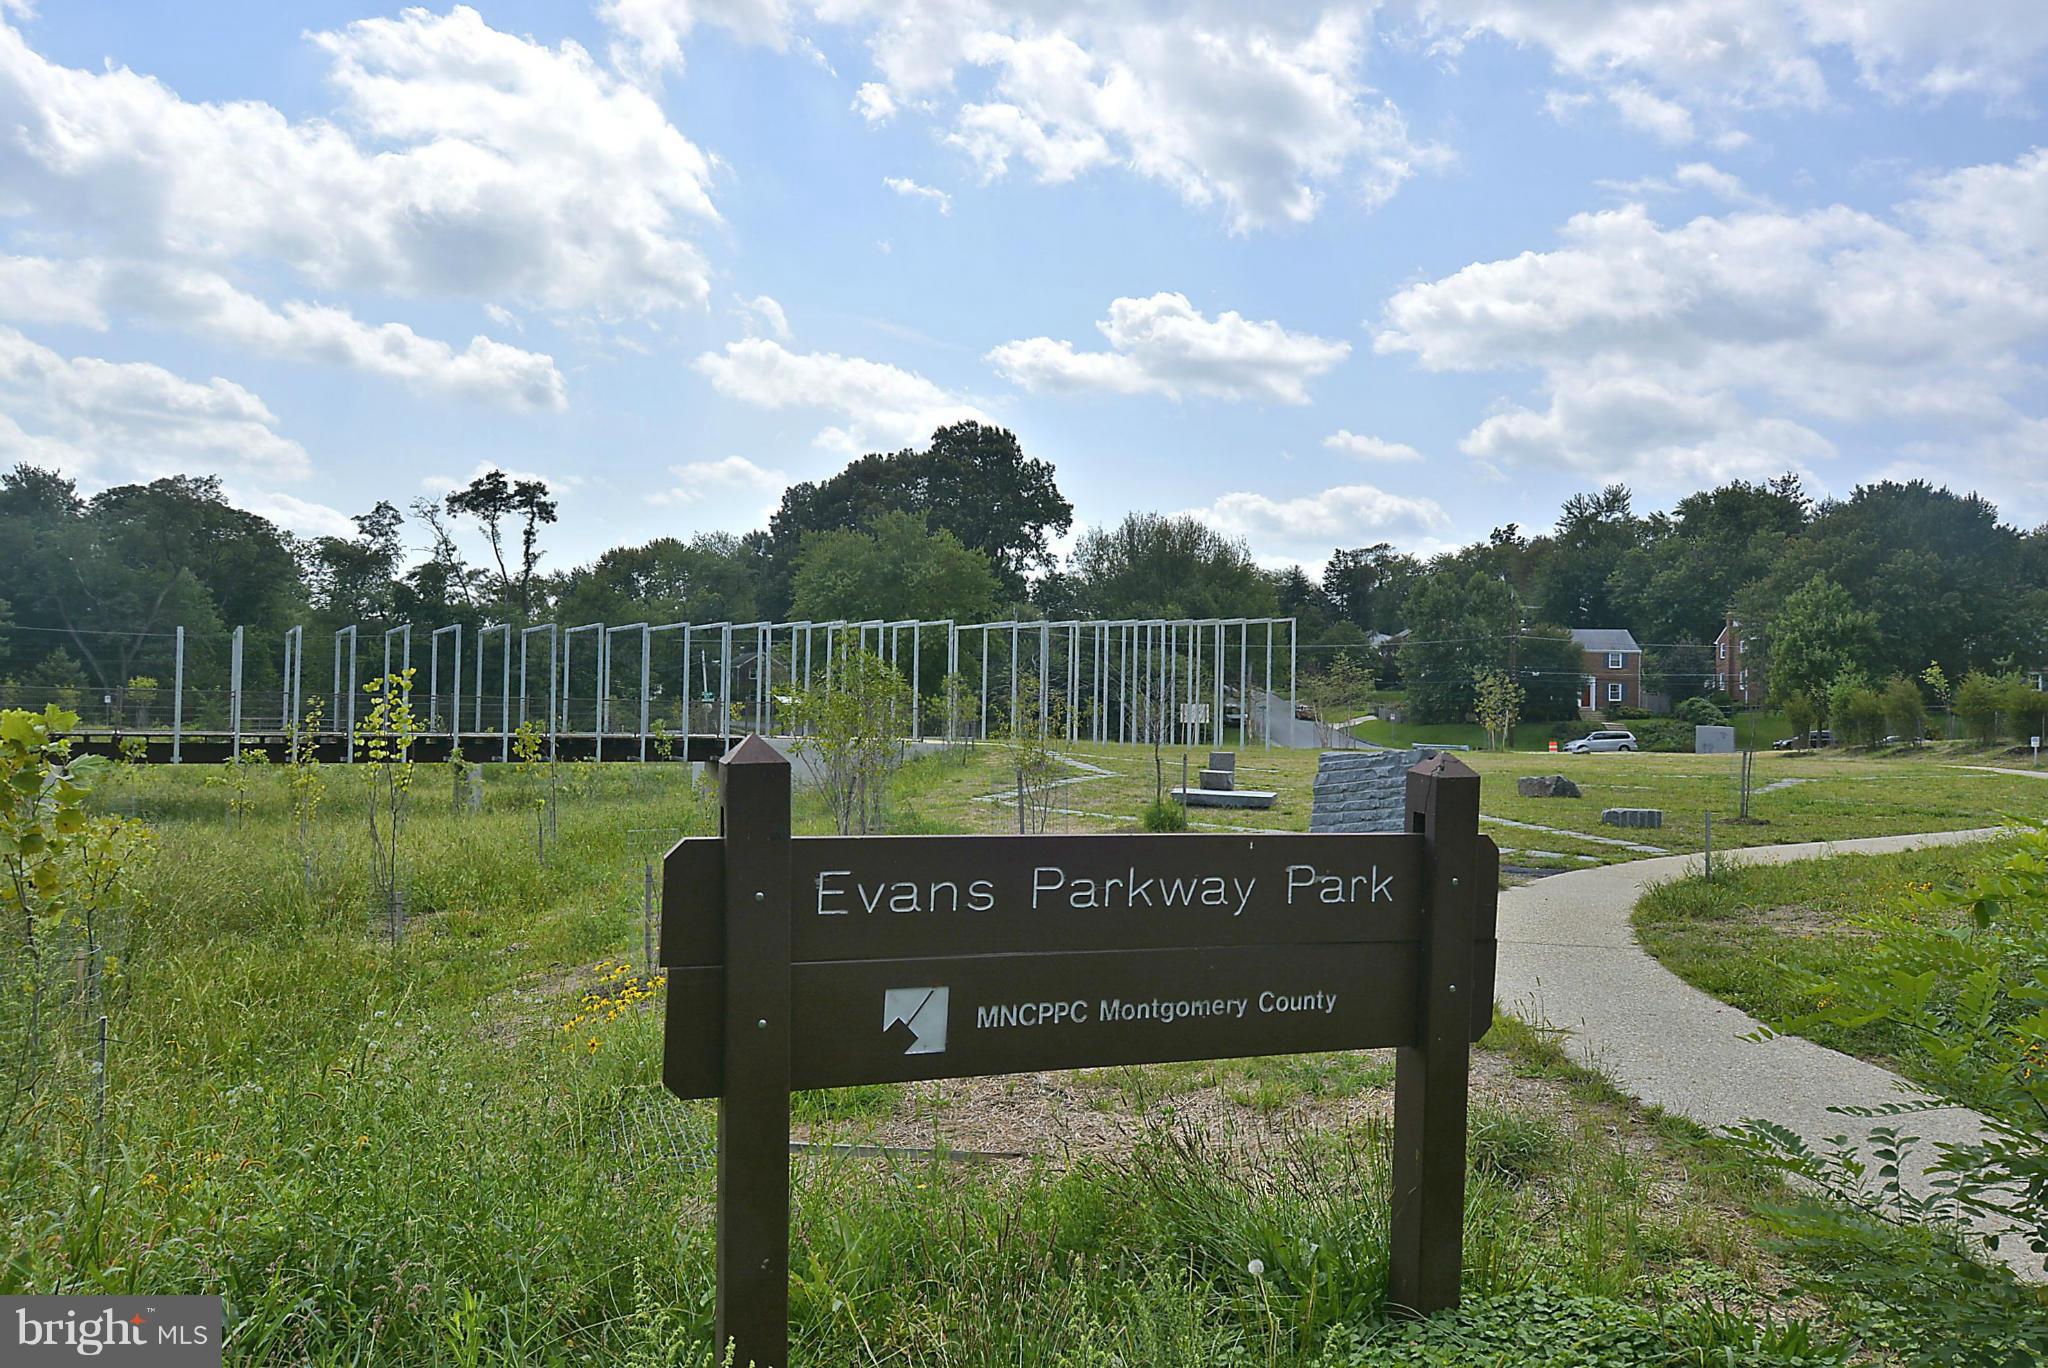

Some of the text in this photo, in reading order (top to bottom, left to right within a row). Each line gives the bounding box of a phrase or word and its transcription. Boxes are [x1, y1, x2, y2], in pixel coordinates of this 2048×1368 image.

[815, 864, 1394, 917] Evans Parkway Park
[976, 990, 1337, 1029] MNCPPC Montgomery County
